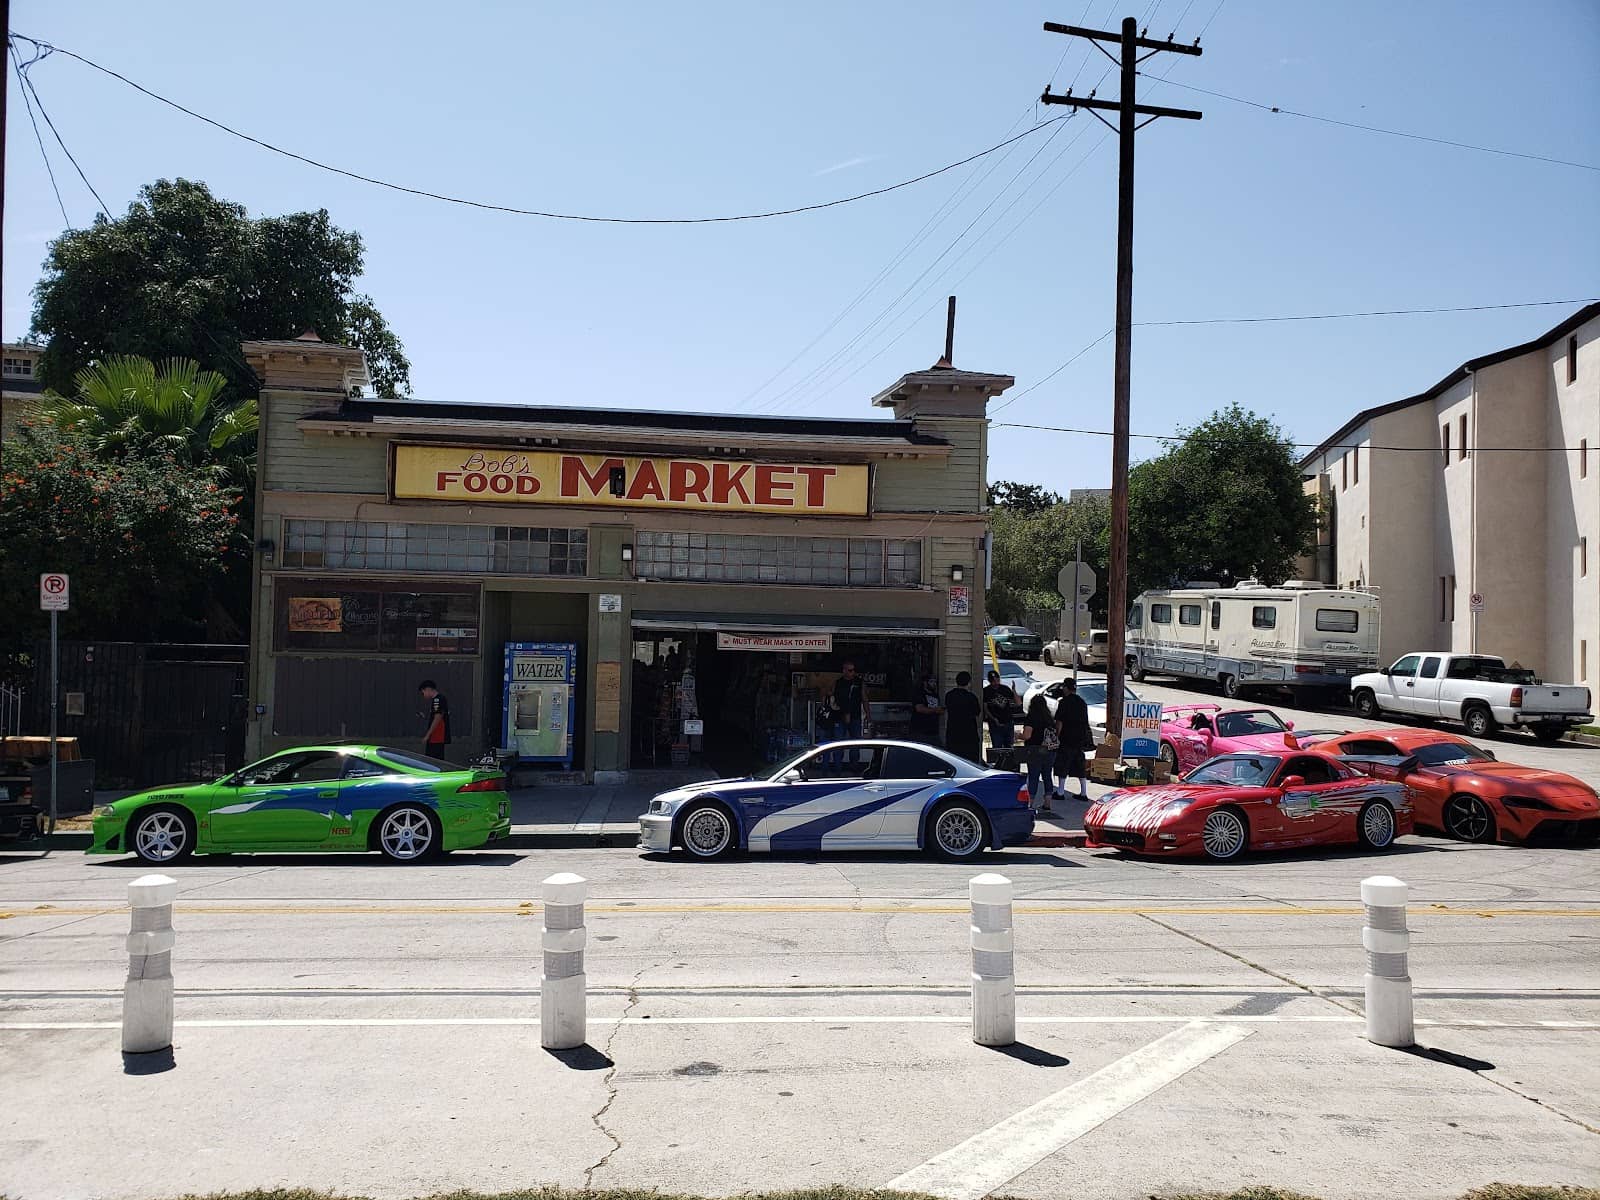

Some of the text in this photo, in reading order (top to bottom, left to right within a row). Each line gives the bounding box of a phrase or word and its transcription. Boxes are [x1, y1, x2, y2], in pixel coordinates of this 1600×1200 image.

[460, 452, 532, 474] Bob's
[437, 456, 836, 507] FOOD MARKET
[732, 637, 751, 645] MUST
[752, 638, 772, 646] WEAR
[804, 639, 827, 647] ENTER
[516, 663, 564, 678] WATER
[1126, 703, 1161, 719] LUCKY
[1125, 718, 1160, 730] RETAILER
